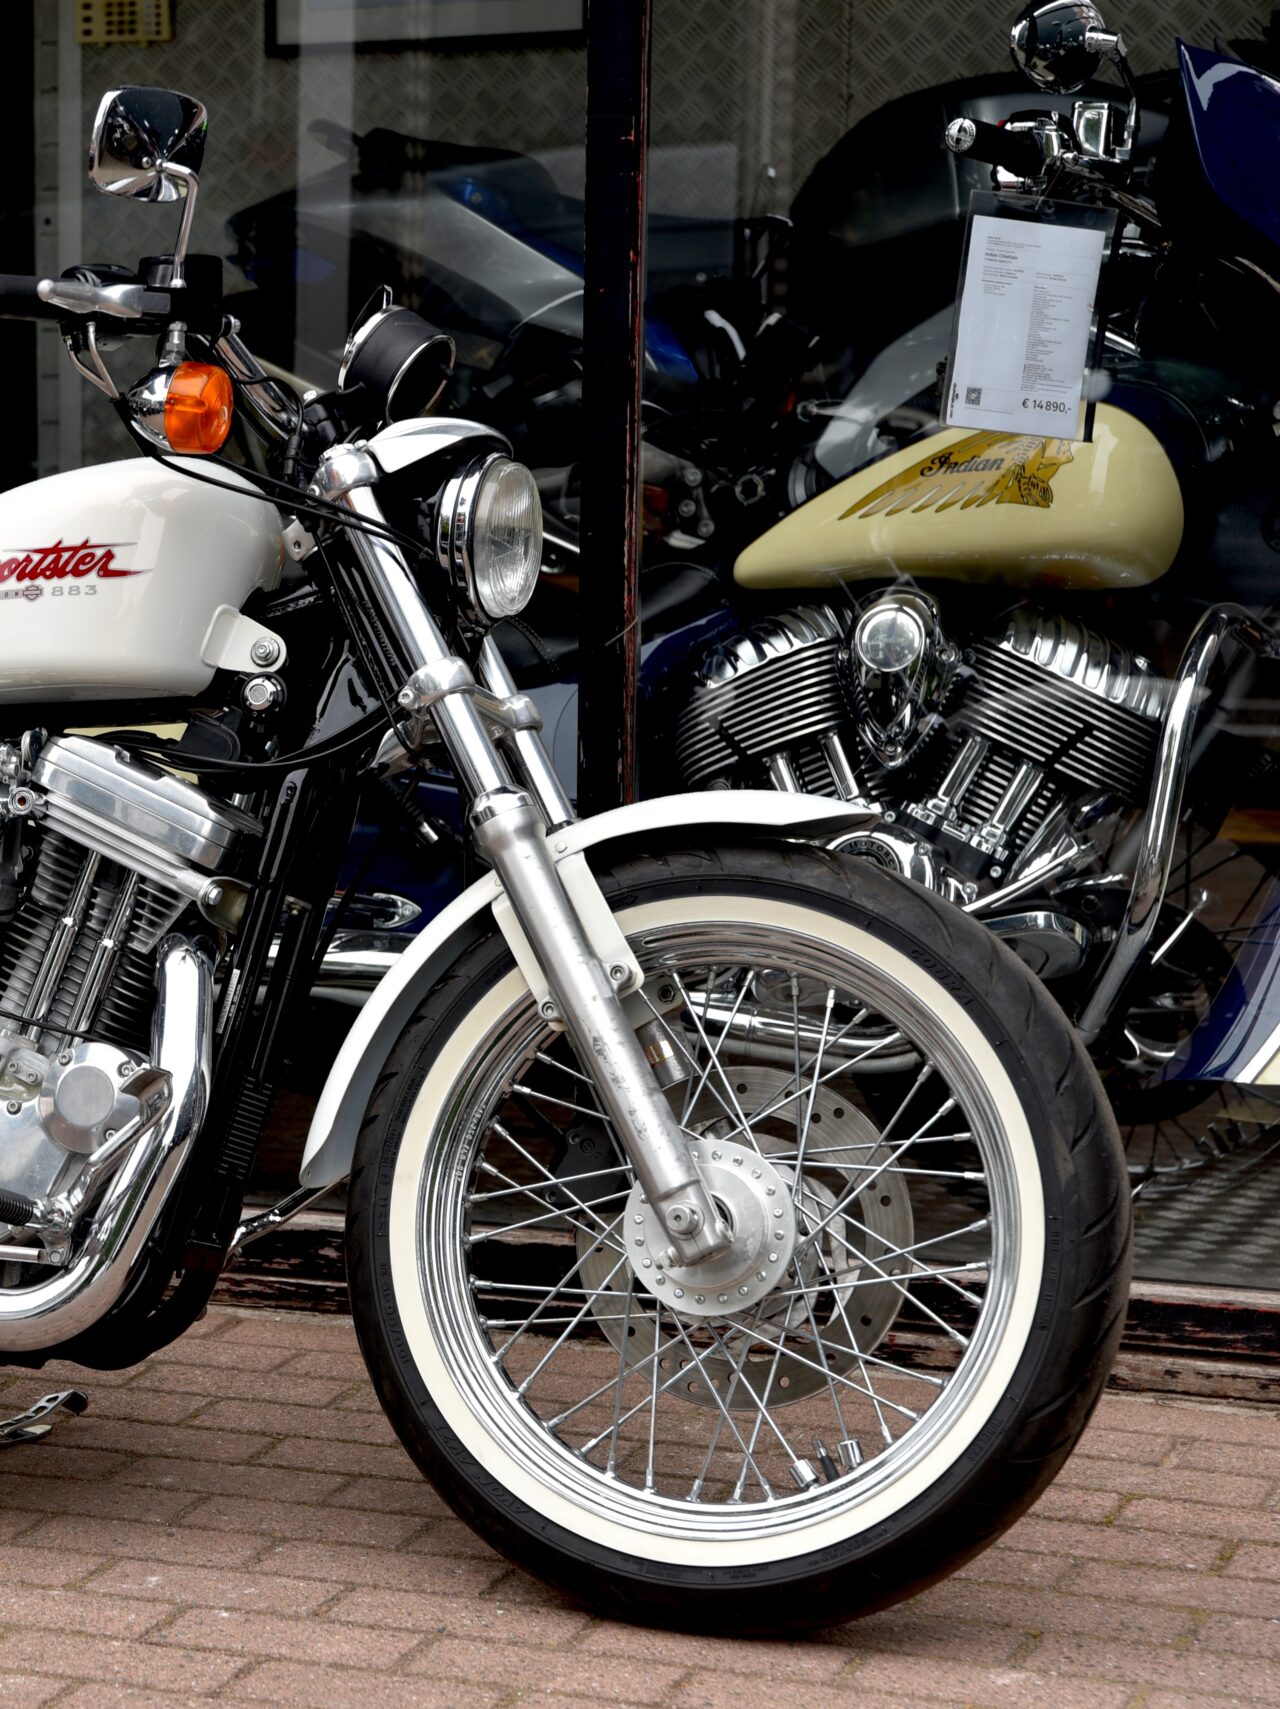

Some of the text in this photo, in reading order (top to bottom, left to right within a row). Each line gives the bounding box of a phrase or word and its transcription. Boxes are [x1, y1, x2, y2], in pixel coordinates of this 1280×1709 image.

[1022, 398, 1030, 409] €
[920, 451, 1004, 478] Indian
[51, 584, 98, 597] 883
[849, 840, 898, 868] MOTORC
[910, 948, 974, 1006] COBRA
[473, 1468, 529, 1516] AVON
